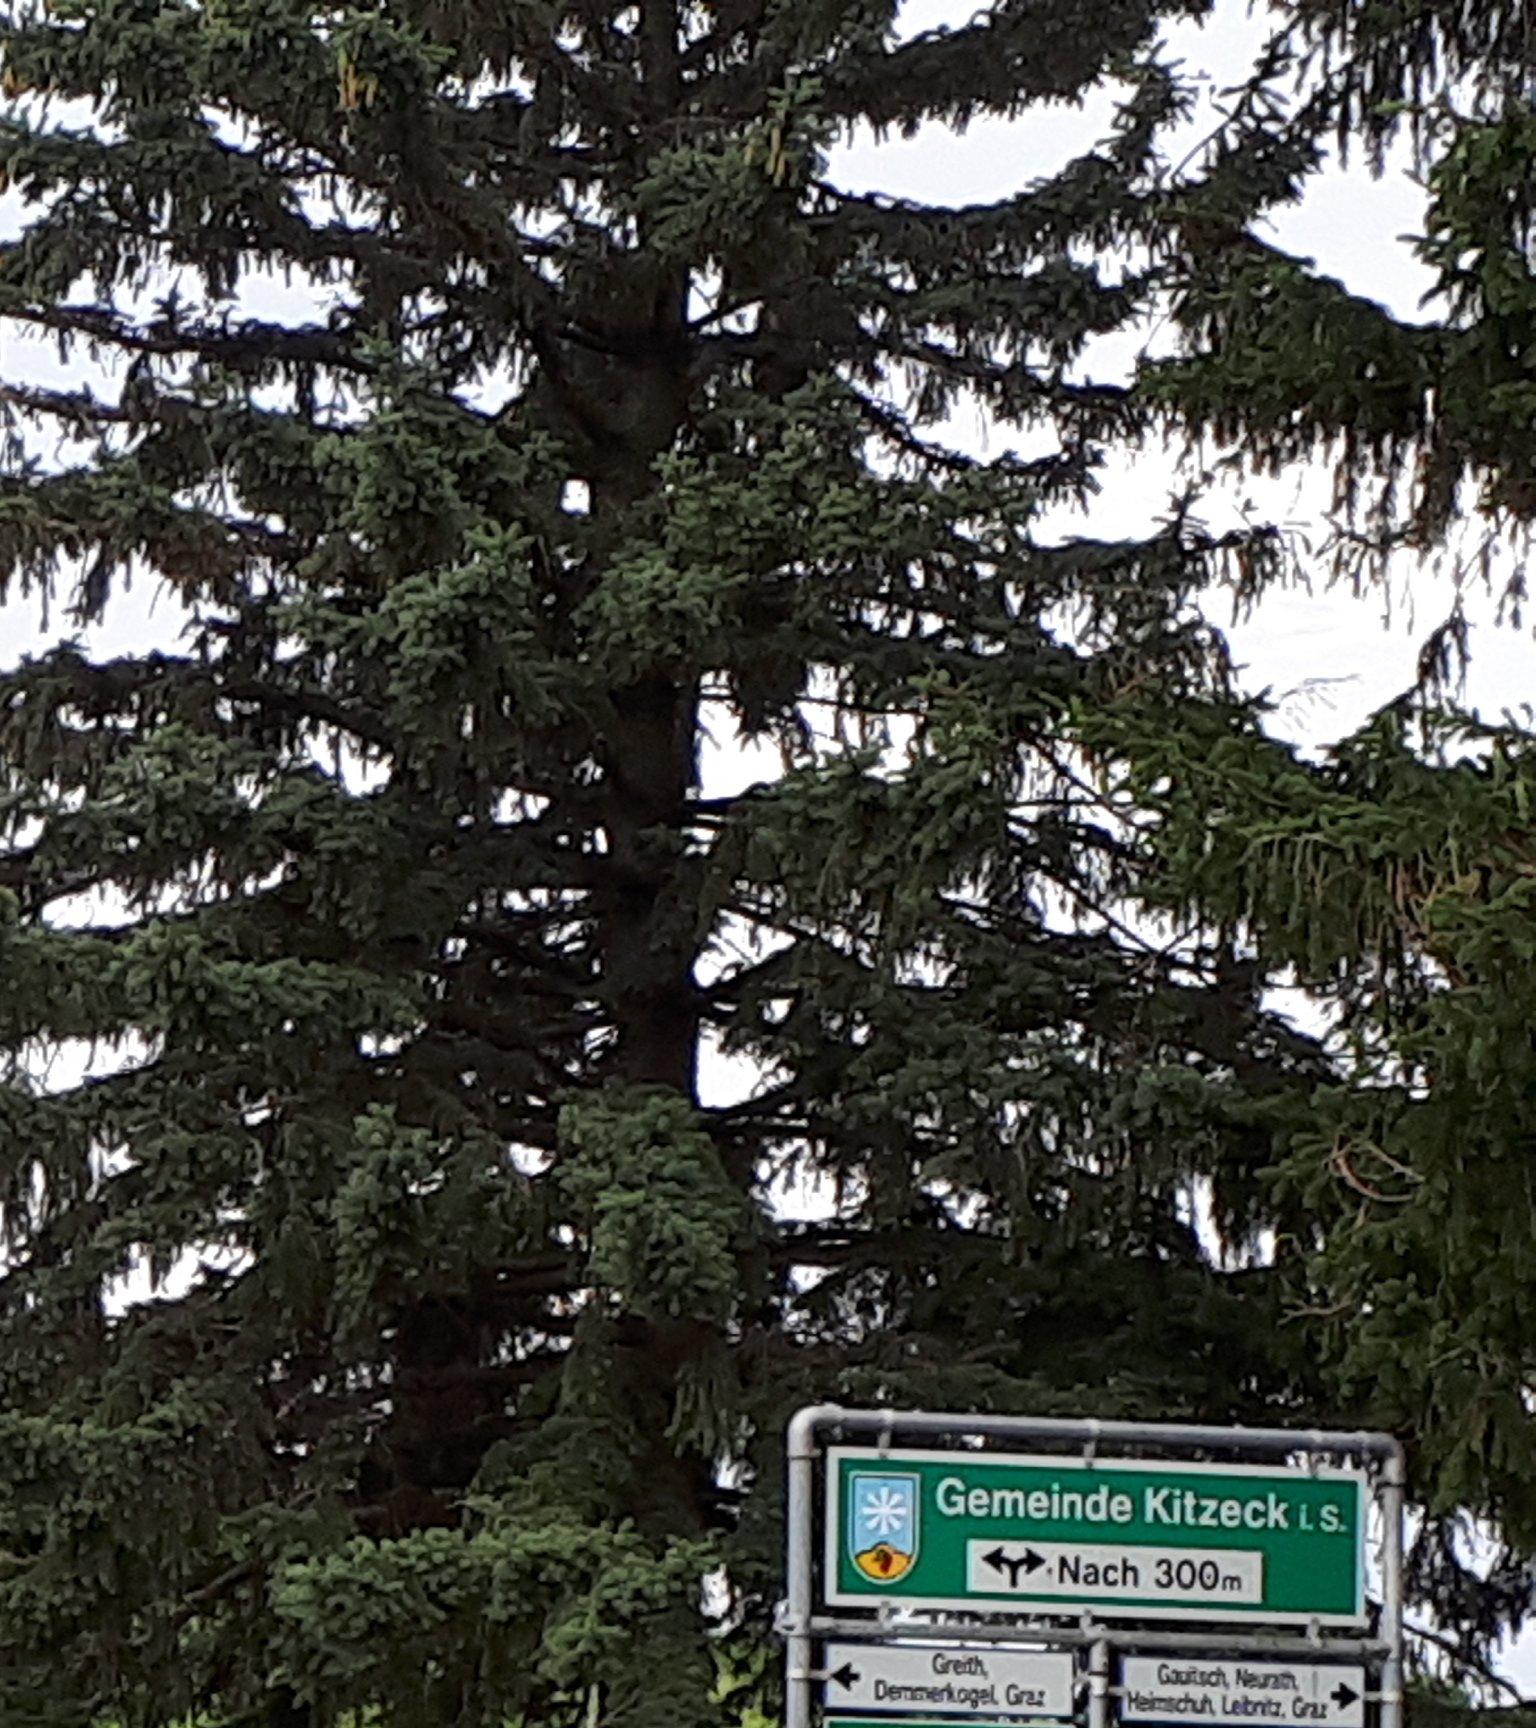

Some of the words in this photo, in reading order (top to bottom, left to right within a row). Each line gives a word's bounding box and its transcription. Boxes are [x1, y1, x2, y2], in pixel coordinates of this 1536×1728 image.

[935, 1477, 1133, 1522] Gemeinde
[1144, 1485, 1289, 1529] Kitzeck
[1058, 1555, 1139, 1588] Nach
[1006, 1684, 1046, 1707] Graz
[1292, 1698, 1328, 1719] Graz
